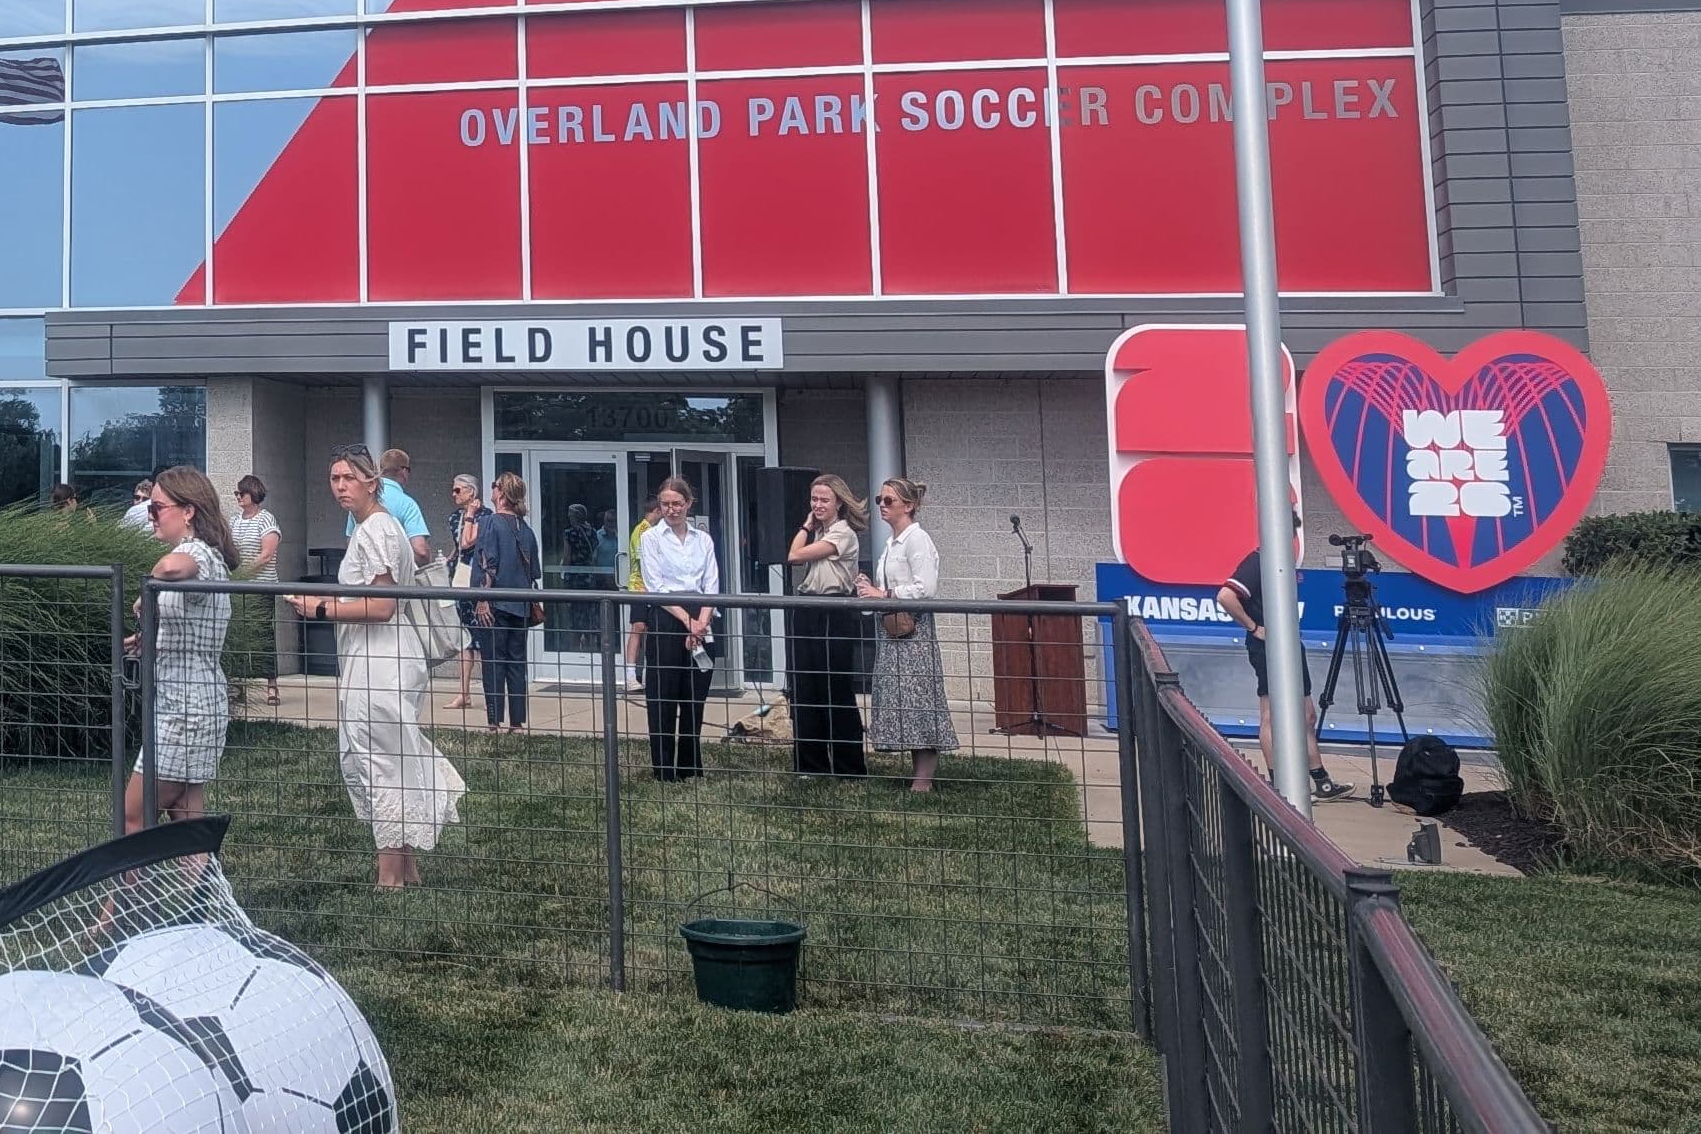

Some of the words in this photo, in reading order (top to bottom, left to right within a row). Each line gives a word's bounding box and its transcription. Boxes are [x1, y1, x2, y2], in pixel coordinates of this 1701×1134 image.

[459, 100, 721, 148] OVERLAND
[748, 93, 881, 137] PARK
[900, 86, 1109, 132] SOCCER
[1135, 78, 1399, 125] COMPLEX
[406, 326, 553, 364] FIELD
[587, 324, 765, 363] HOUSE
[1402, 409, 1508, 450] WE
[1407, 481, 1512, 517] 26
